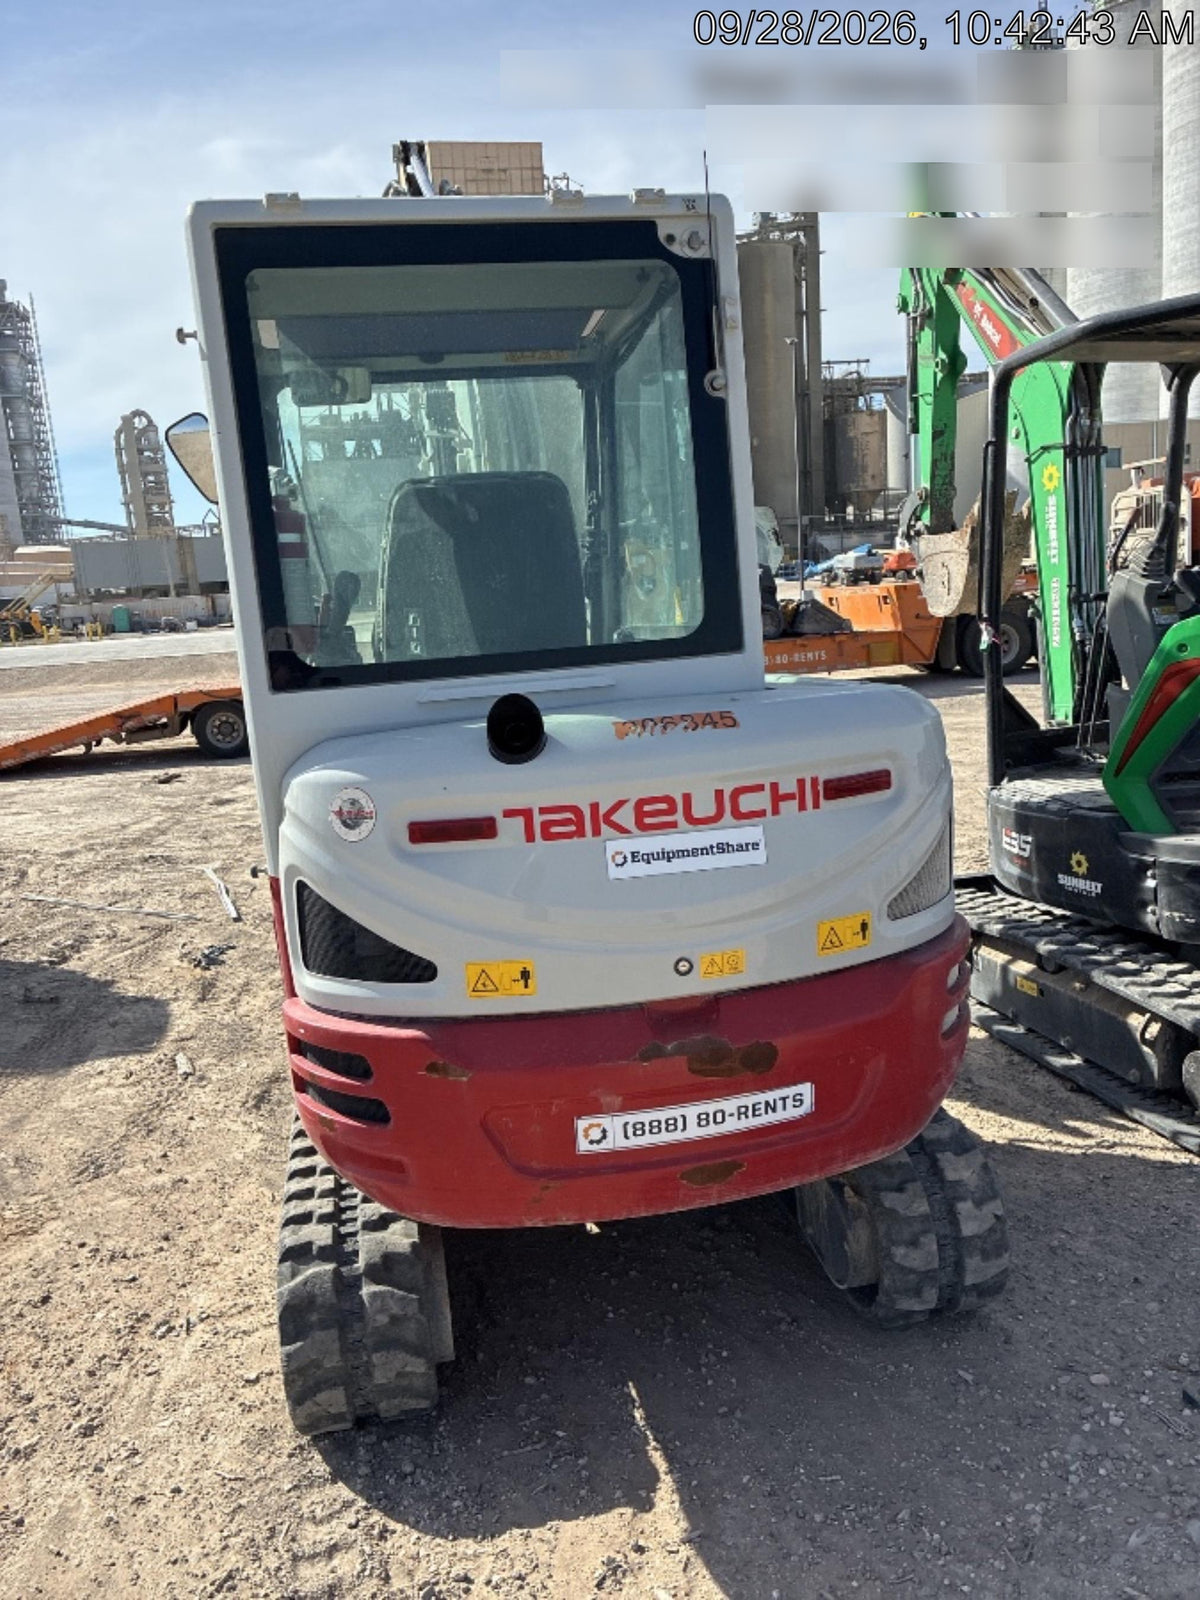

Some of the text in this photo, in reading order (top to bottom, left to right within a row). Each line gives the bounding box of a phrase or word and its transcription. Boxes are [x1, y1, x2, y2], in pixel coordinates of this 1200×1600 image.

[630, 839, 761, 865] EquipmentShare
[623, 1092, 804, 1140] (888) 80-RENTS
